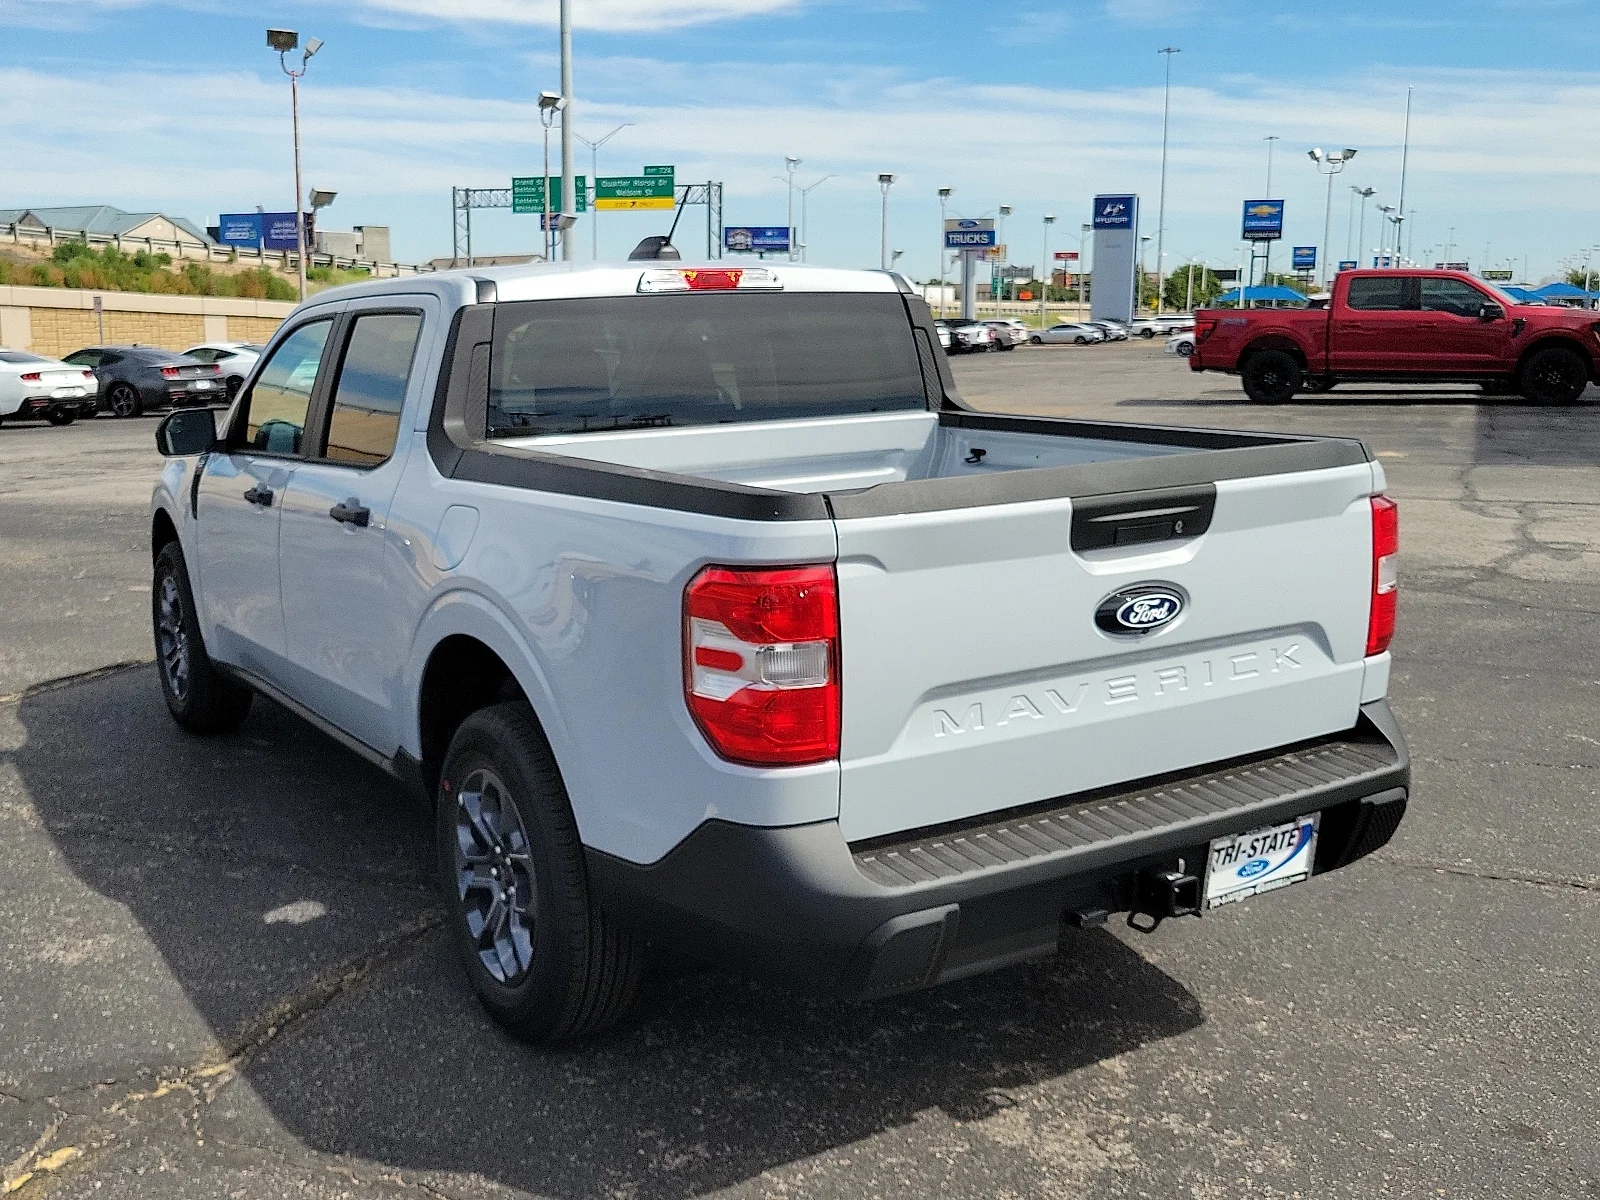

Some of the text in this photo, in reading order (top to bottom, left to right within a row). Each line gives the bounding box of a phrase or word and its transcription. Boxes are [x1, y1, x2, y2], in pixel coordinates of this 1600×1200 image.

[948, 233, 989, 244] TRUCKS
[1129, 598, 1170, 624] Ford
[933, 643, 1302, 737] MAVERICK
[1212, 827, 1301, 867] TRI-STATE
